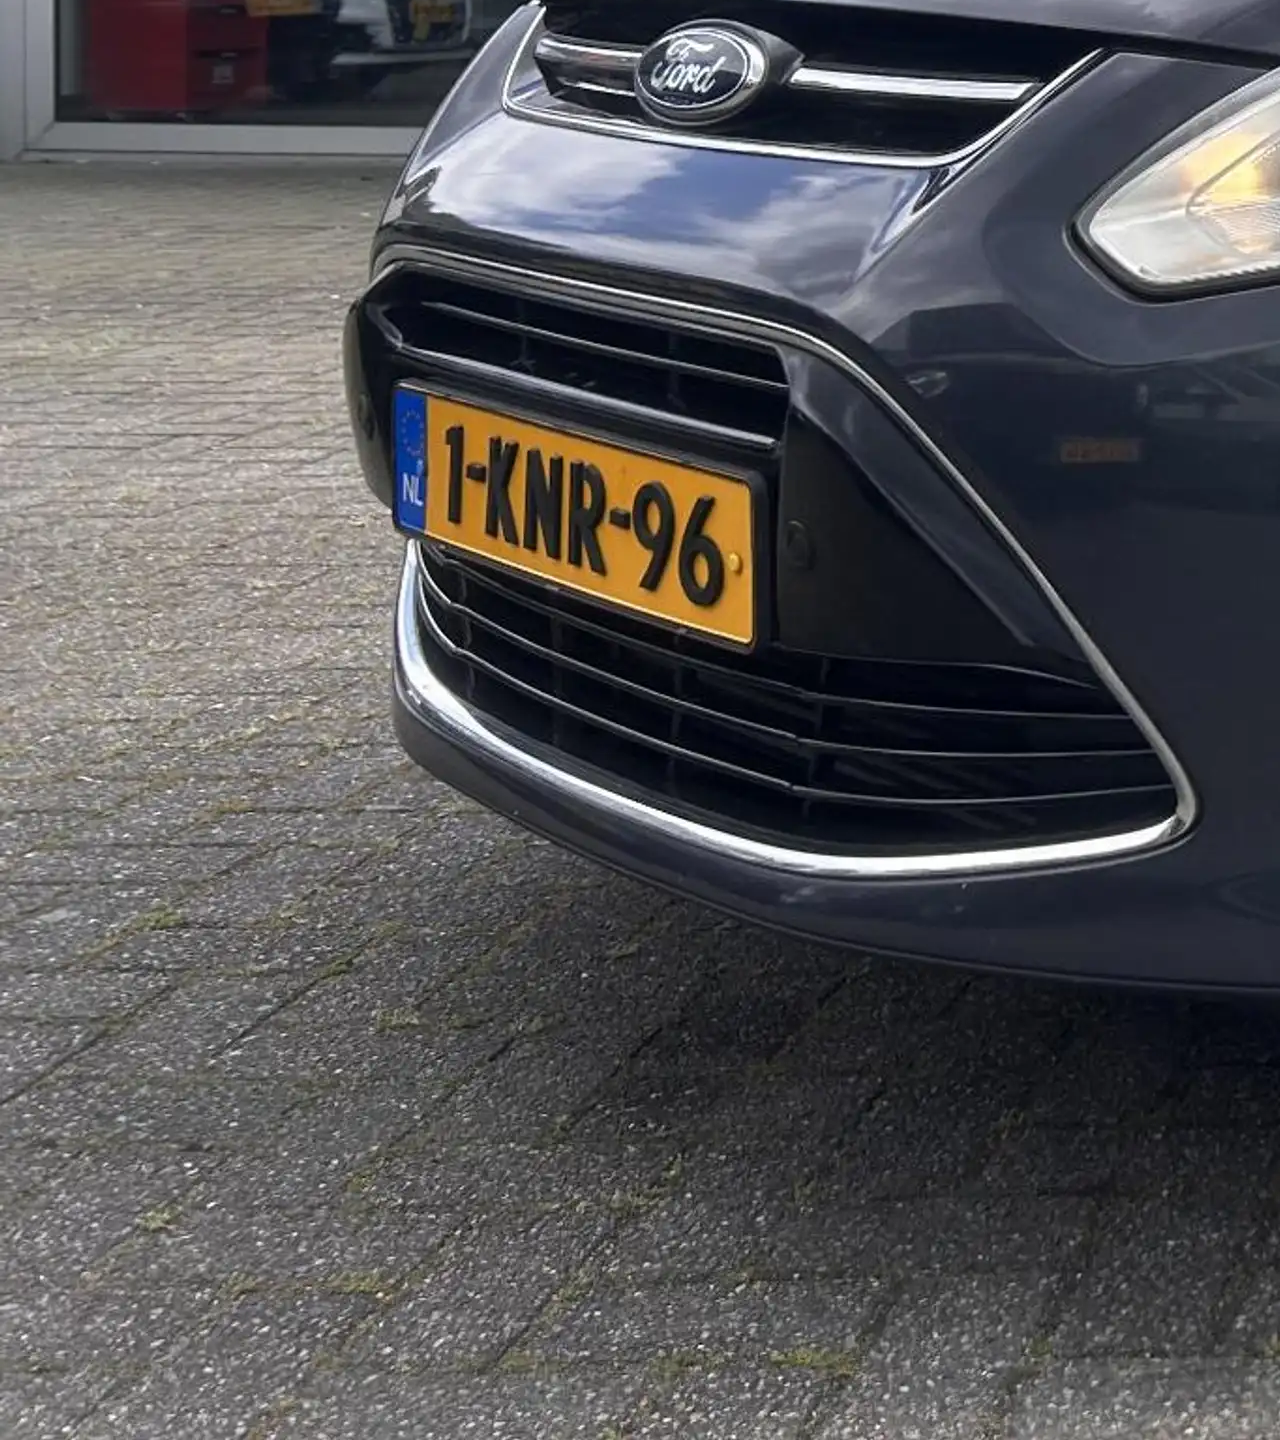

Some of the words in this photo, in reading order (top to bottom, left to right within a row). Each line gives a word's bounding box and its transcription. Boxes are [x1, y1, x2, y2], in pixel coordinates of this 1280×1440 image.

[650, 37, 728, 94] Ford
[402, 474, 424, 507] NL
[445, 425, 725, 607] 1-KNR-96
